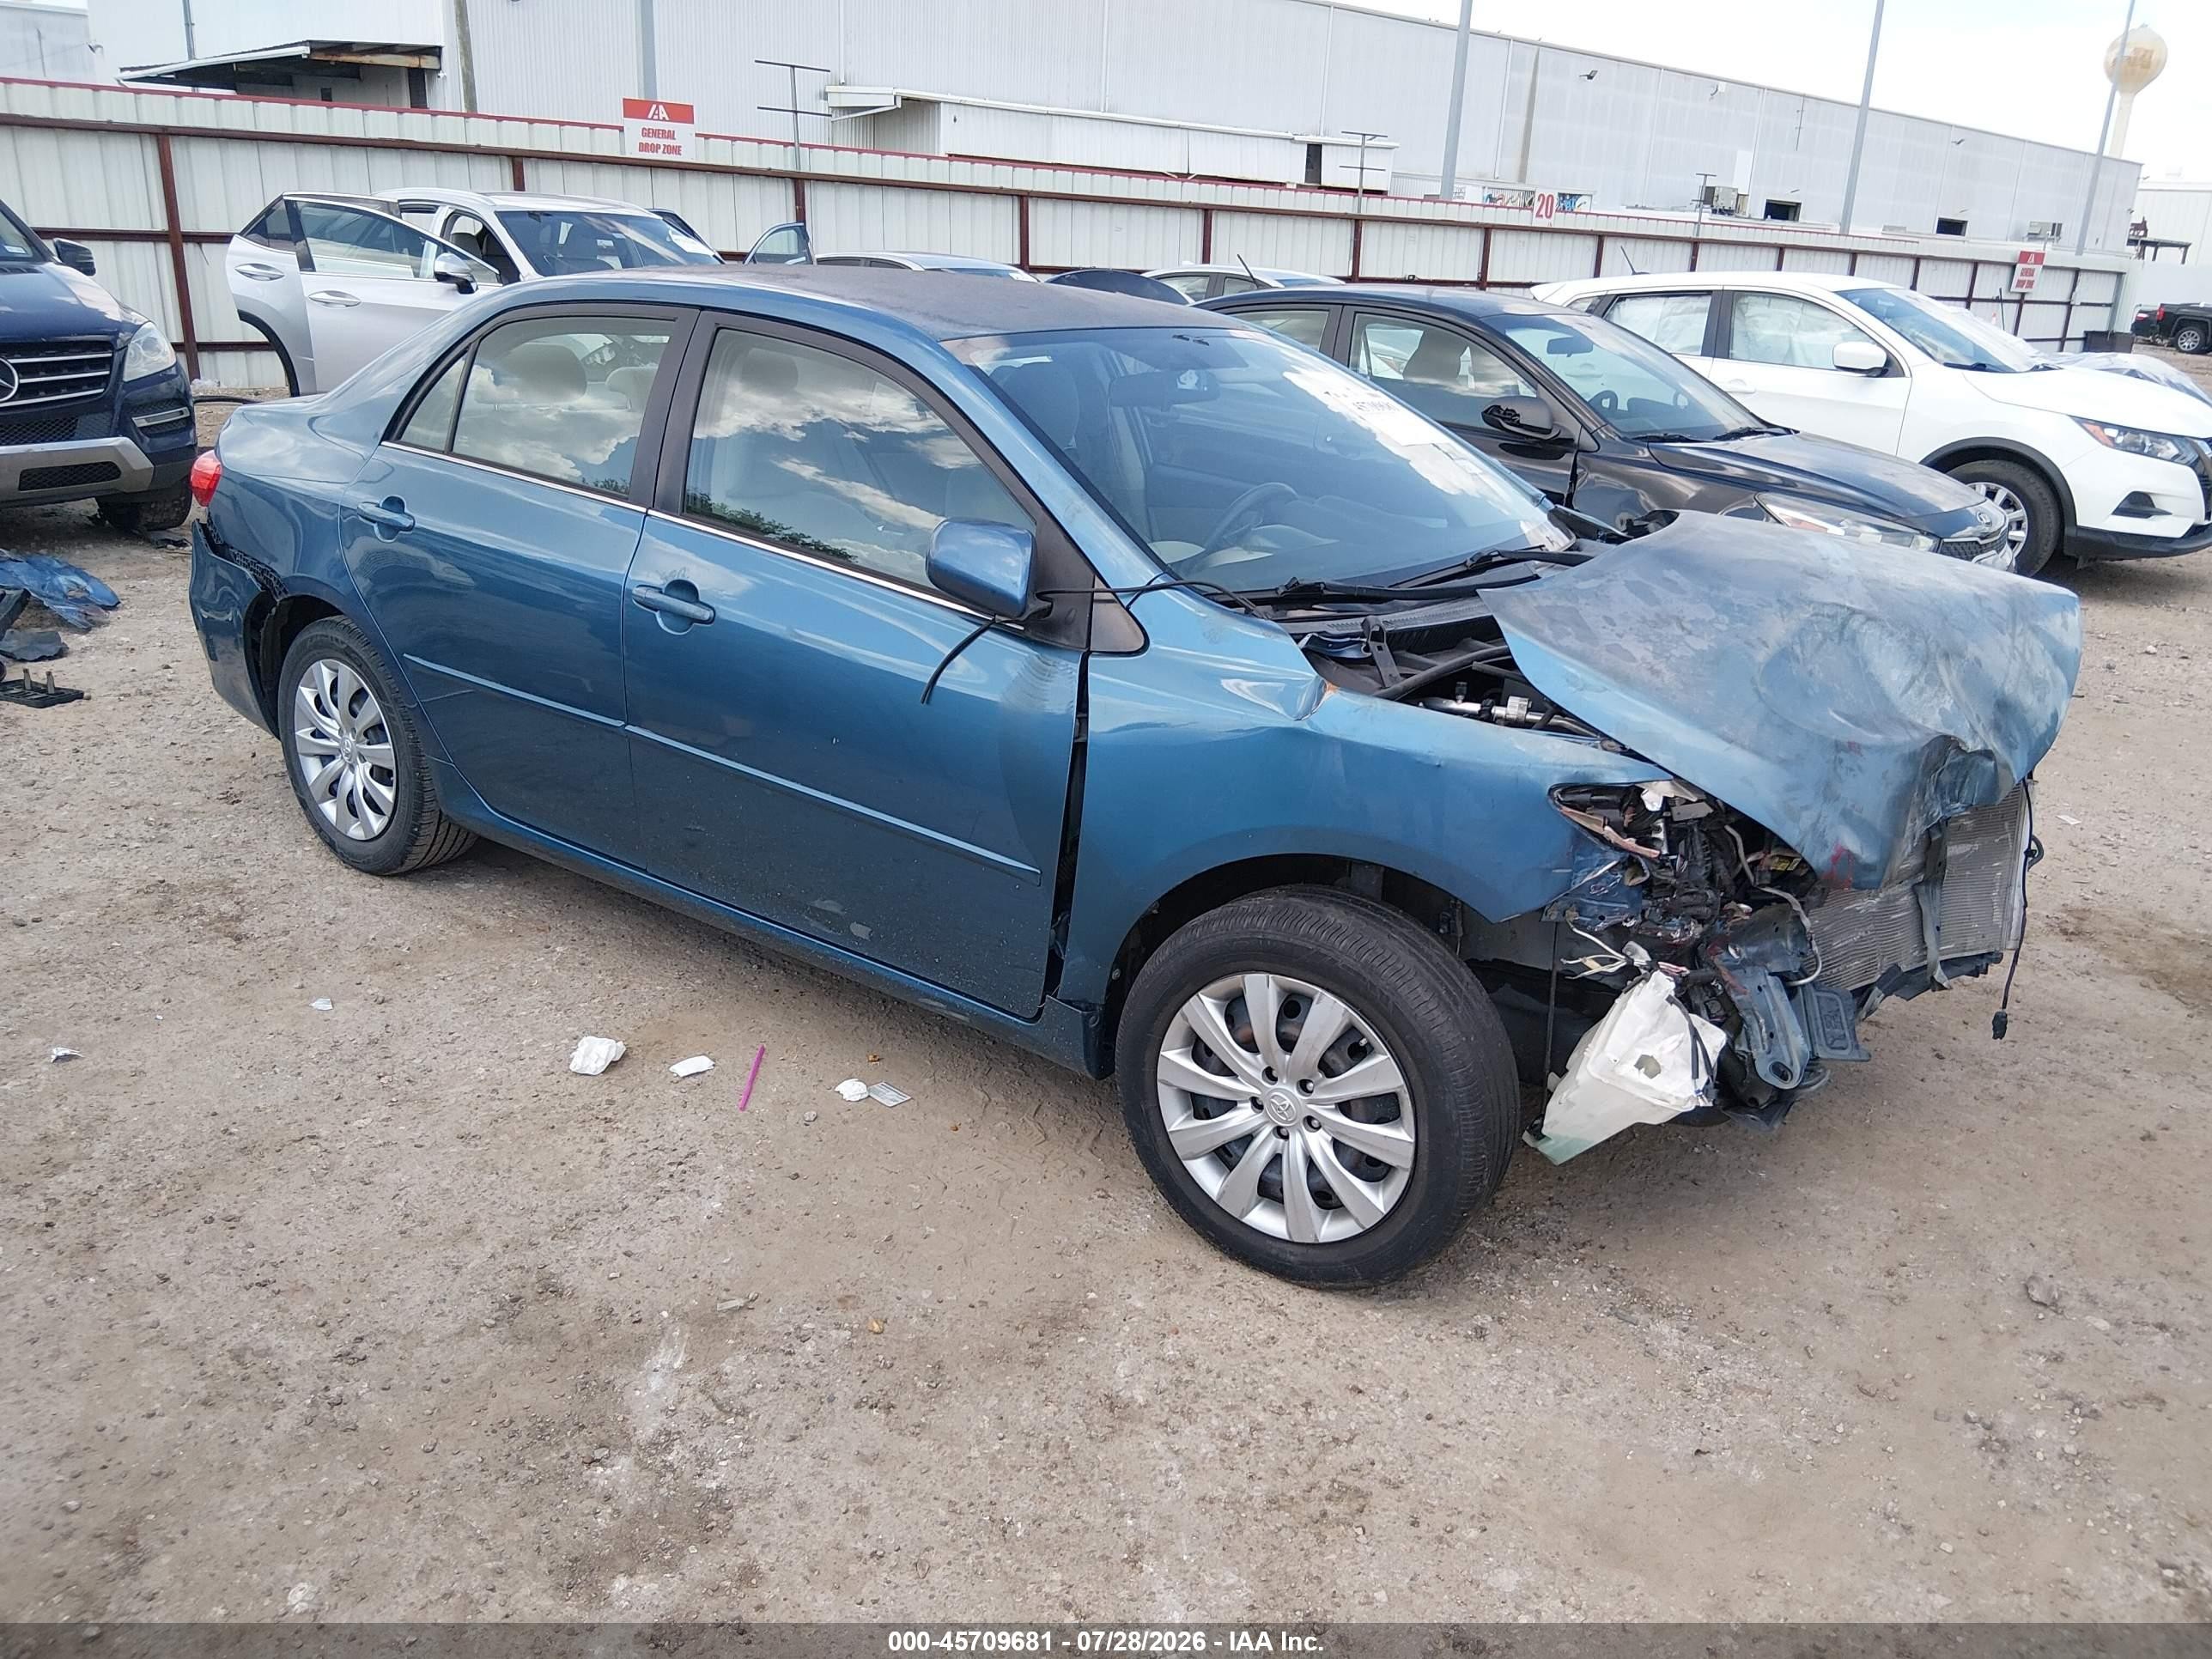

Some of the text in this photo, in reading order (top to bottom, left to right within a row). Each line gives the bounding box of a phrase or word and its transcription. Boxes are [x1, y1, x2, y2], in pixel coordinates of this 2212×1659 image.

[641, 127, 677, 140] GENERAL
[638, 142, 683, 156] DROP ZONE
[1535, 193, 1555, 219] 20
